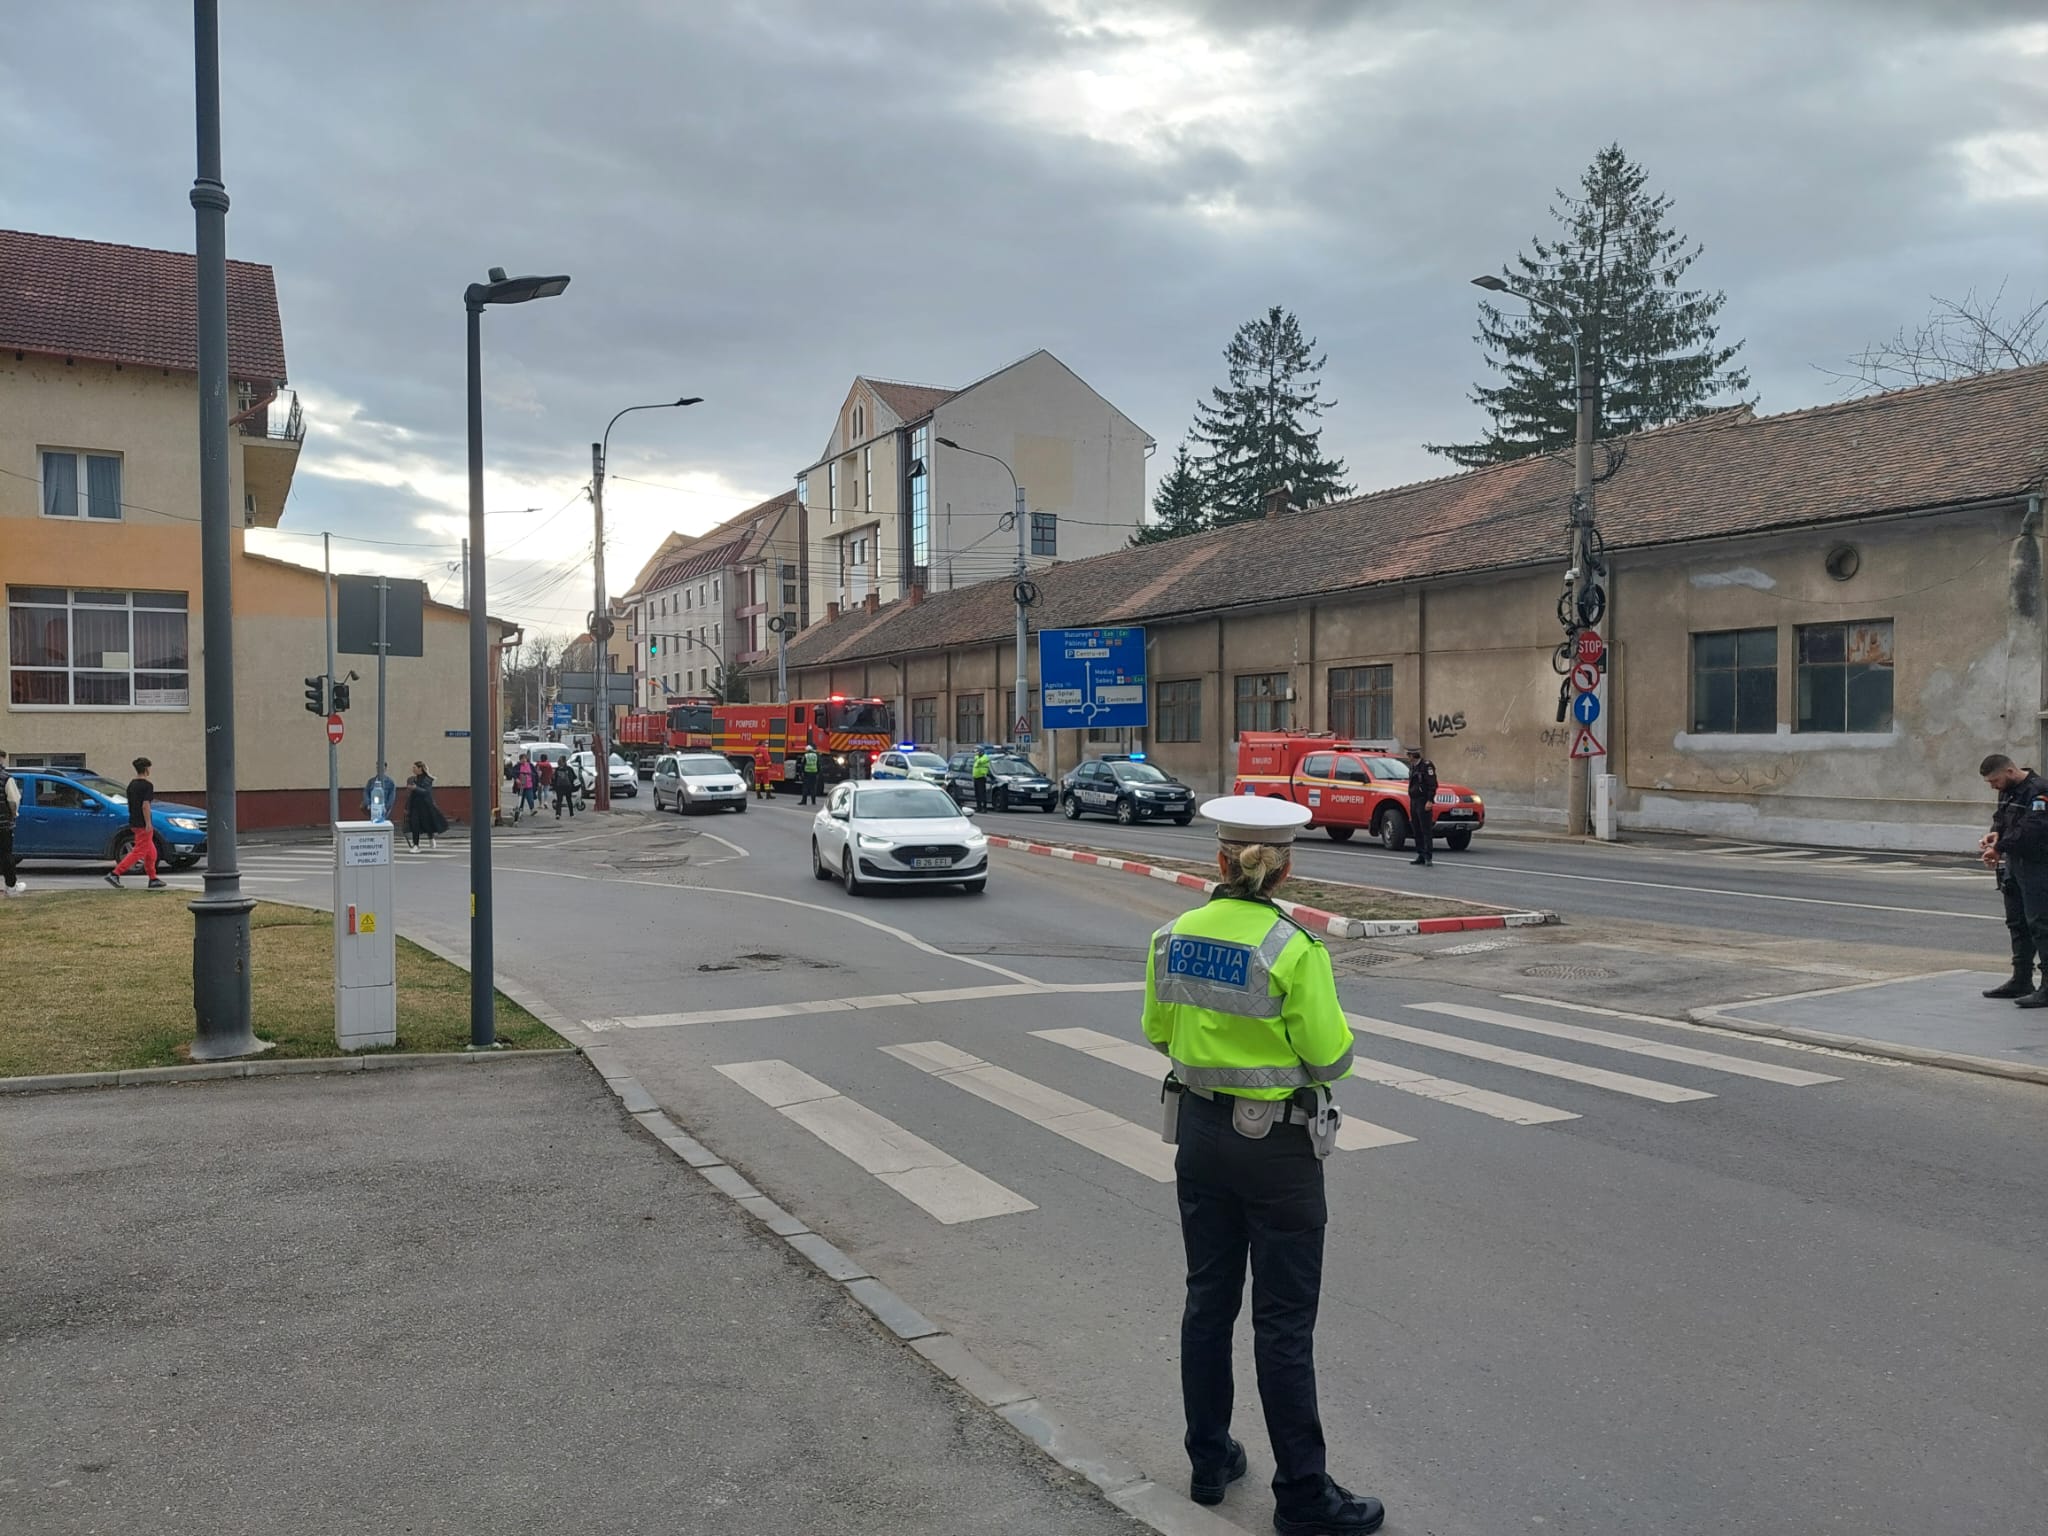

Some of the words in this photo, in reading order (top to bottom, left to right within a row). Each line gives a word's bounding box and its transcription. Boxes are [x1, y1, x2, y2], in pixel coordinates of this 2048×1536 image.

[1578, 640, 1602, 654] STOP
[1428, 712, 1467, 733] WAS
[1171, 941, 1243, 968] POLITIA
[1170, 959, 1241, 983] LOCALA
